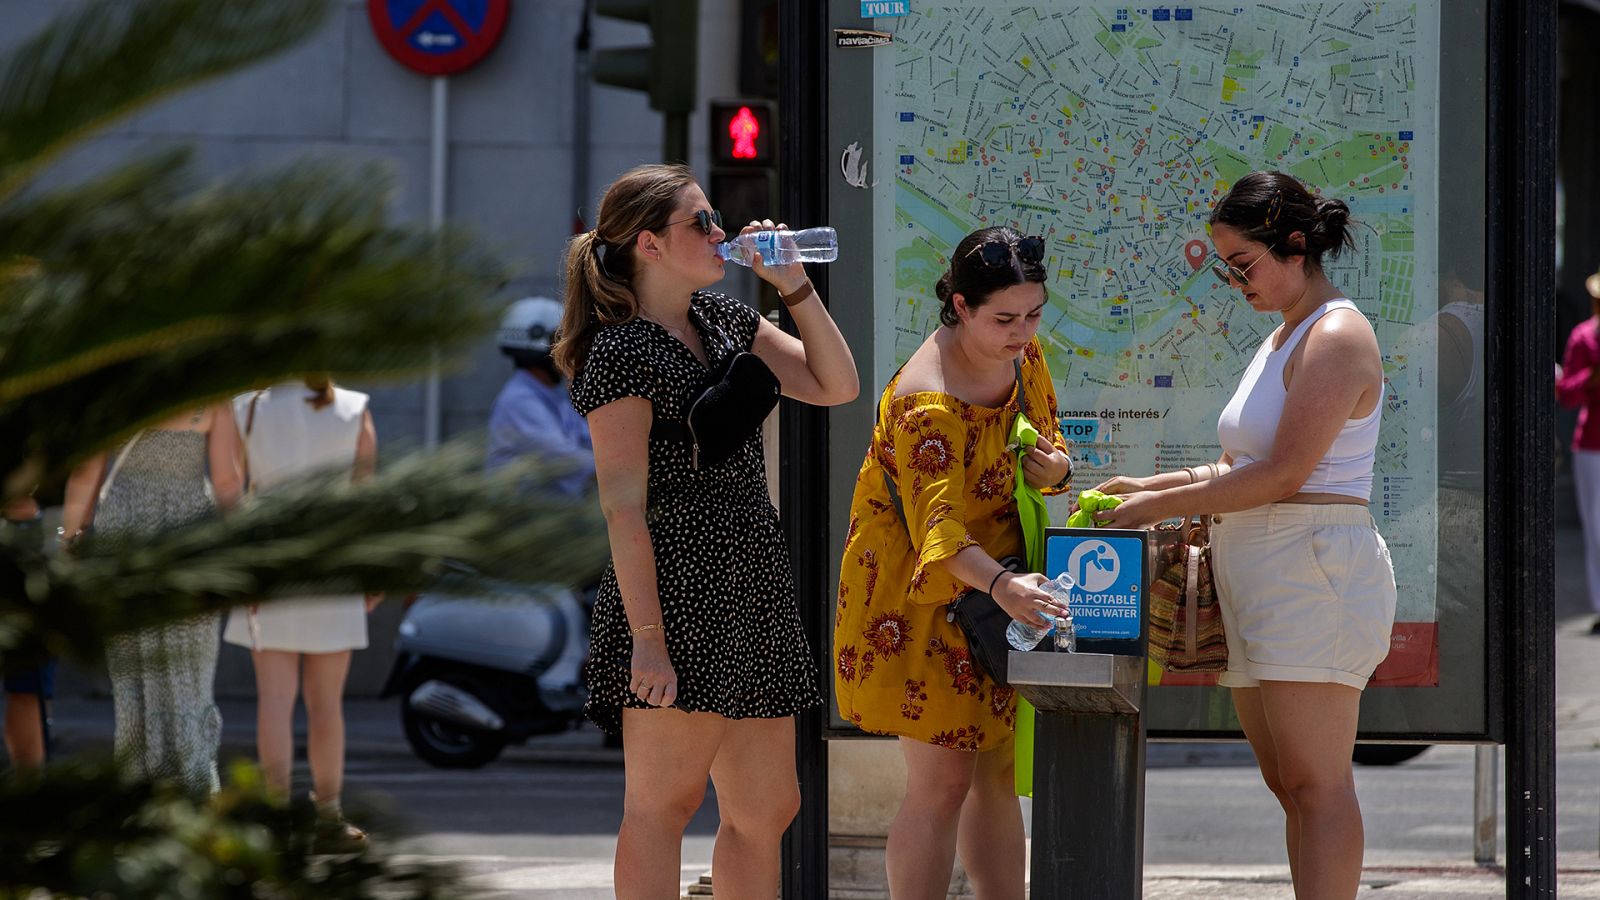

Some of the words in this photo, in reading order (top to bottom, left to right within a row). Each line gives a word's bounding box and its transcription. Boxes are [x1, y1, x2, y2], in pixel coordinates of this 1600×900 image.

[866, 2, 905, 16] TOUR
[1056, 410, 1097, 418] ugares
[1100, 408, 1115, 419] de
[1118, 408, 1160, 419] interés
[1162, 408, 1170, 419] /
[1059, 425, 1093, 436] STOP
[1069, 594, 1083, 604] UA
[1086, 594, 1137, 605] POTABLE
[1069, 607, 1101, 617] NKING
[1102, 608, 1137, 618] WATER
